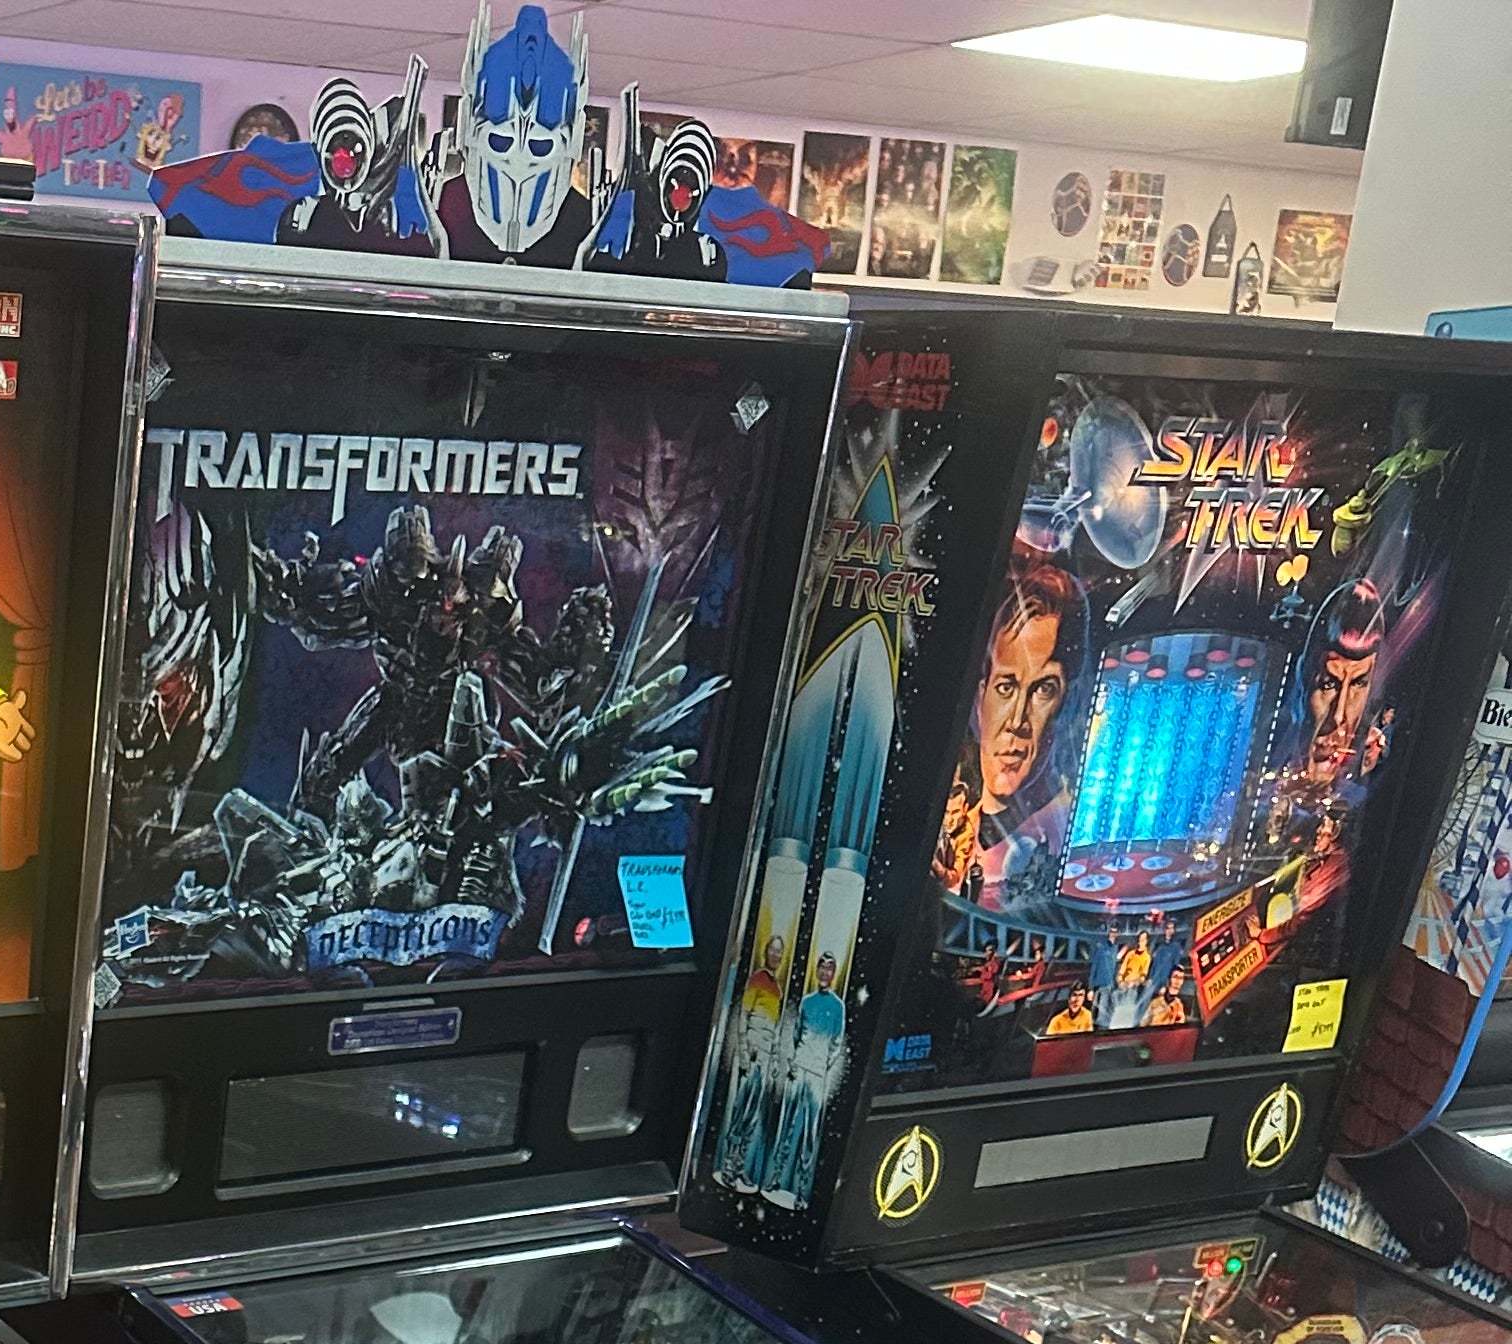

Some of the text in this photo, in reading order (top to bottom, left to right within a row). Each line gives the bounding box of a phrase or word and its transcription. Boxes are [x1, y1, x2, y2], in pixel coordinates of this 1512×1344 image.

[31, 90, 132, 178] WEIRD
[896, 352, 951, 380] DATA
[145, 428, 586, 527] TRANSFORMERS
[1128, 415, 1296, 486] STAR
[1184, 487, 1326, 550] TREK
[829, 565, 937, 616] TREK
[1207, 947, 1260, 1001] TRANSPORTER
[186, 1301, 232, 1318] USA
